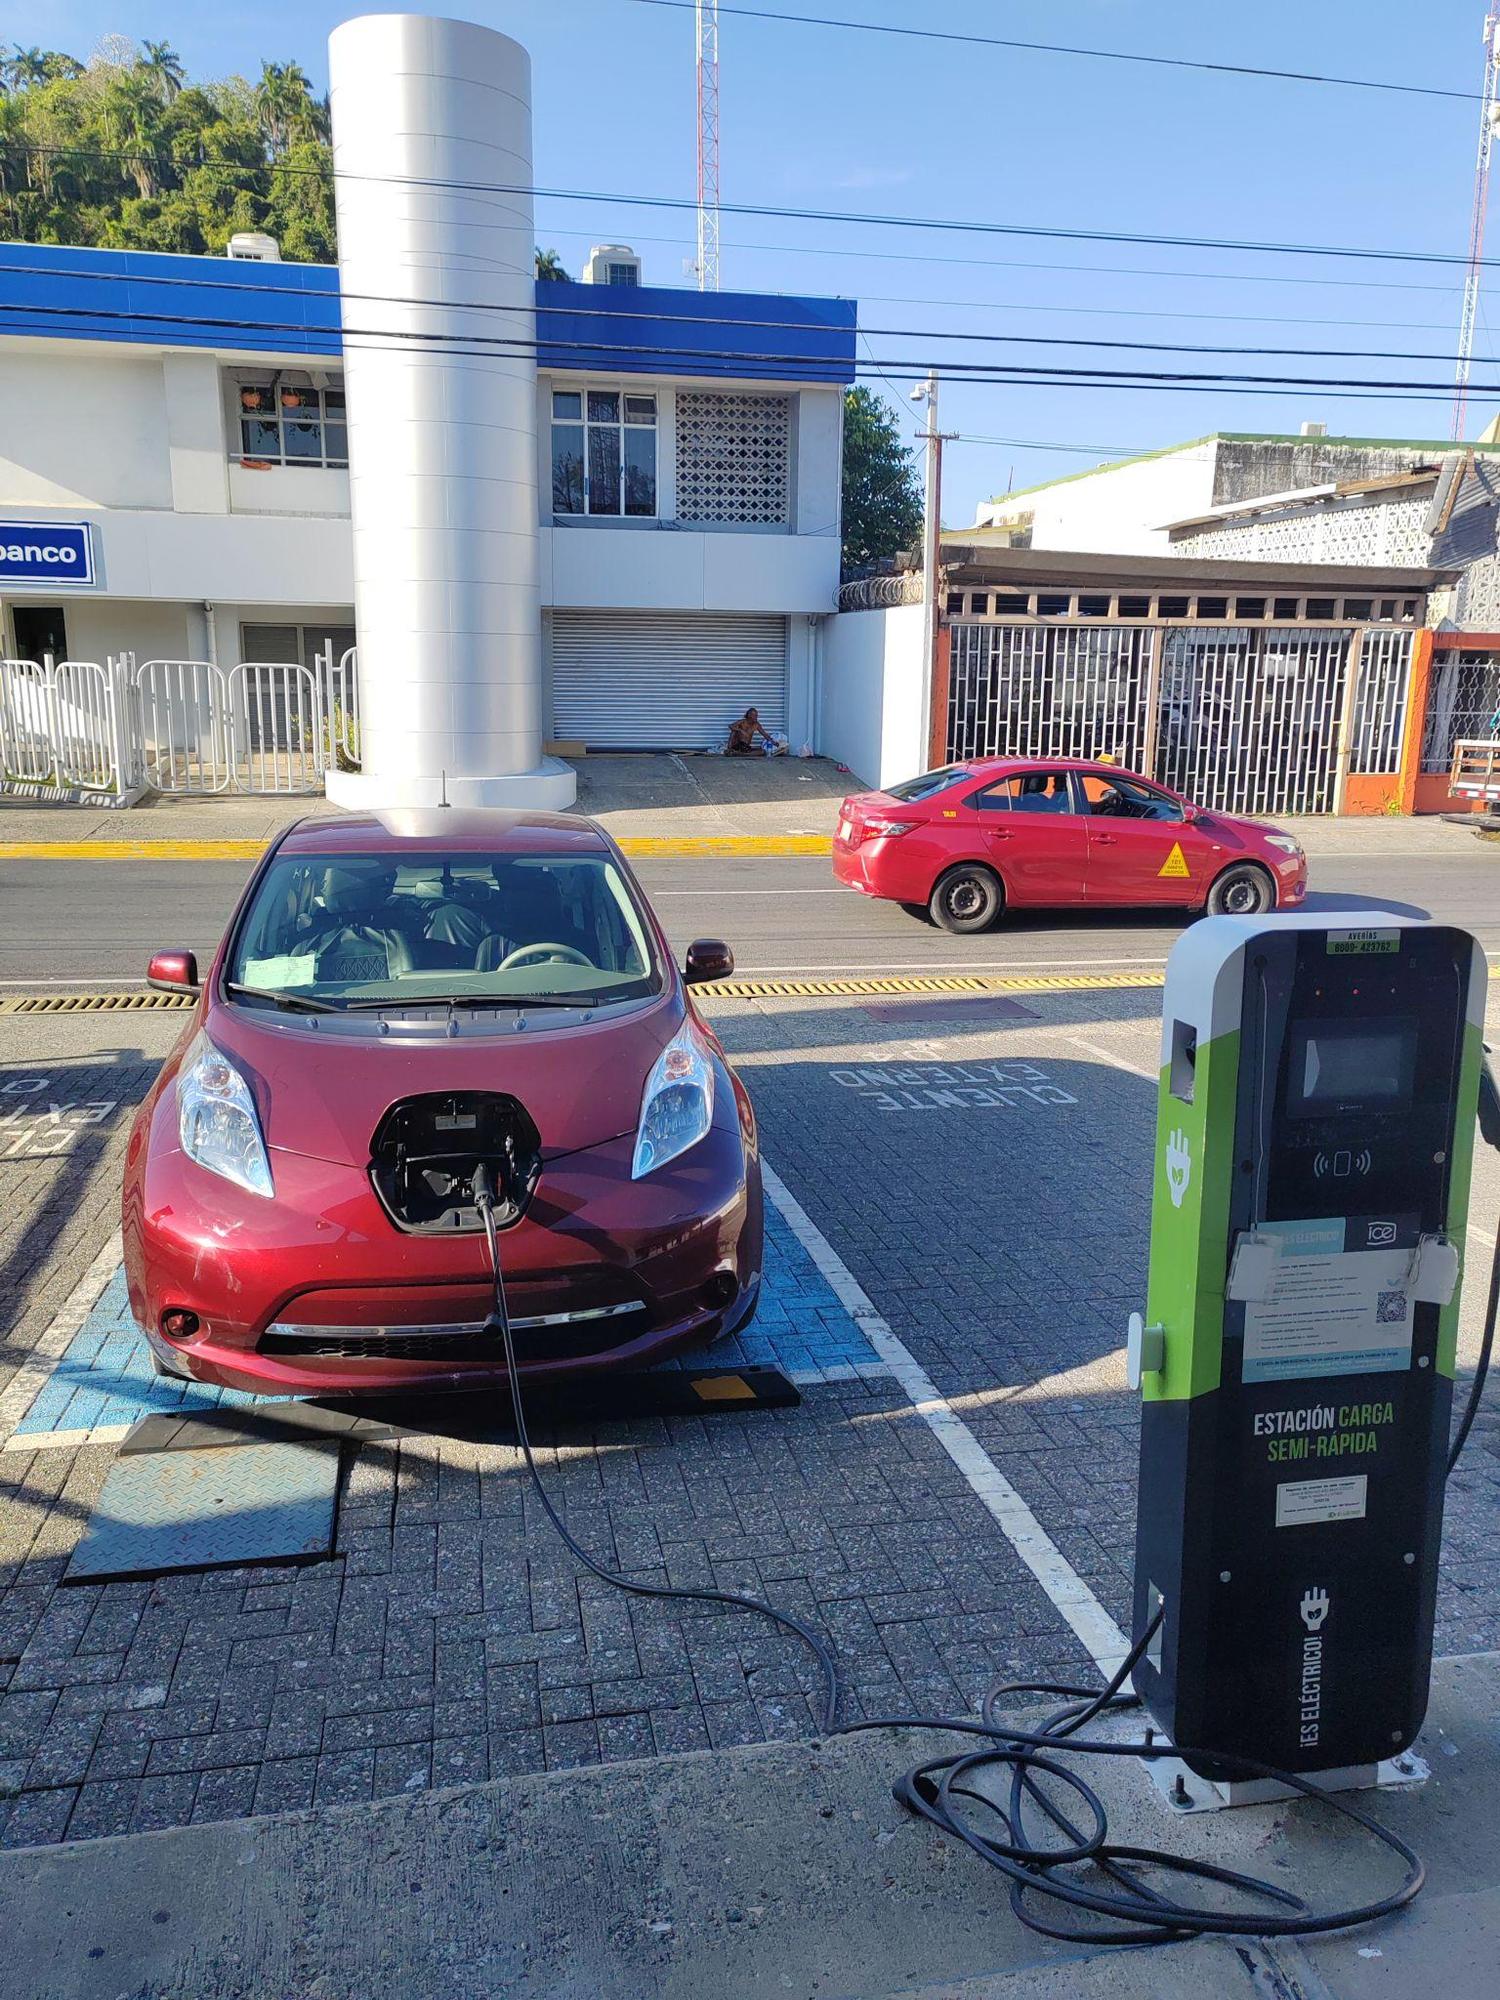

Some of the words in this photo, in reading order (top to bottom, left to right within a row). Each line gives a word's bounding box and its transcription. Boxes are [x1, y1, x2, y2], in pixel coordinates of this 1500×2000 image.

[1348, 931, 1377, 941] AVERÍAS
[828, 1063, 1051, 1088] EXTERNO
[859, 1085, 1079, 1111] CLIENTE
[1254, 1404, 1335, 1436] ESTACIÓN
[1338, 1402, 1394, 1428] CARGA
[1267, 1431, 1377, 1461] SEMI-RÁPIDA
[1298, 1635, 1323, 1721] ELÉCTRICO!
